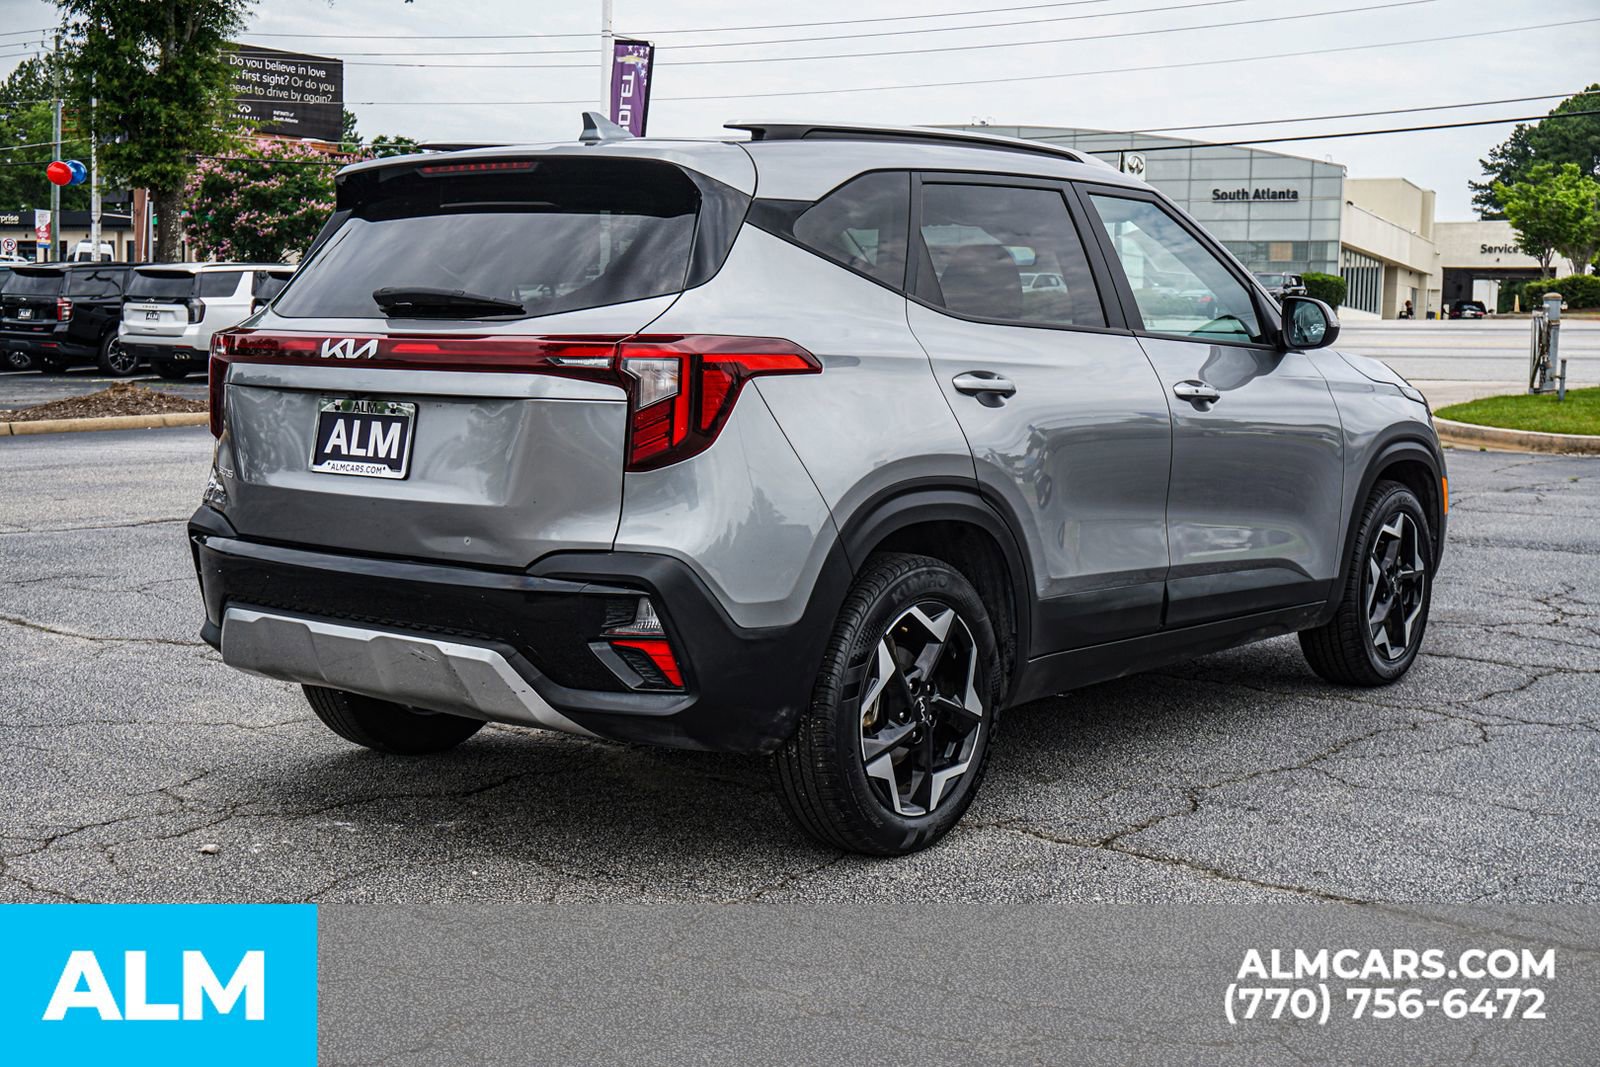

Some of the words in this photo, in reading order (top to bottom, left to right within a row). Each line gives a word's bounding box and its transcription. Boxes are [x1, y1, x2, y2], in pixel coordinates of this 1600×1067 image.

[229, 54, 244, 66] Do
[245, 59, 263, 69] you
[265, 58, 296, 73] believe
[298, 64, 306, 75] in
[308, 65, 326, 78] love
[241, 69, 260, 82] first
[262, 72, 289, 86] sight?
[291, 76, 303, 87] Or
[305, 78, 316, 89] do
[319, 82, 335, 93] you
[254, 86, 265, 96] to
[266, 87, 289, 99] drive
[291, 89, 301, 102] by
[303, 94, 332, 104] again?
[1212, 187, 1249, 200] South
[1252, 187, 1299, 200] Atlanta
[0, 213, 19, 224] prise
[1480, 243, 1519, 254] Service
[320, 338, 379, 359] KIA
[352, 400, 377, 414] ALM
[323, 418, 402, 459] ALM
[330, 462, 383, 474] ALMCARS.COM
